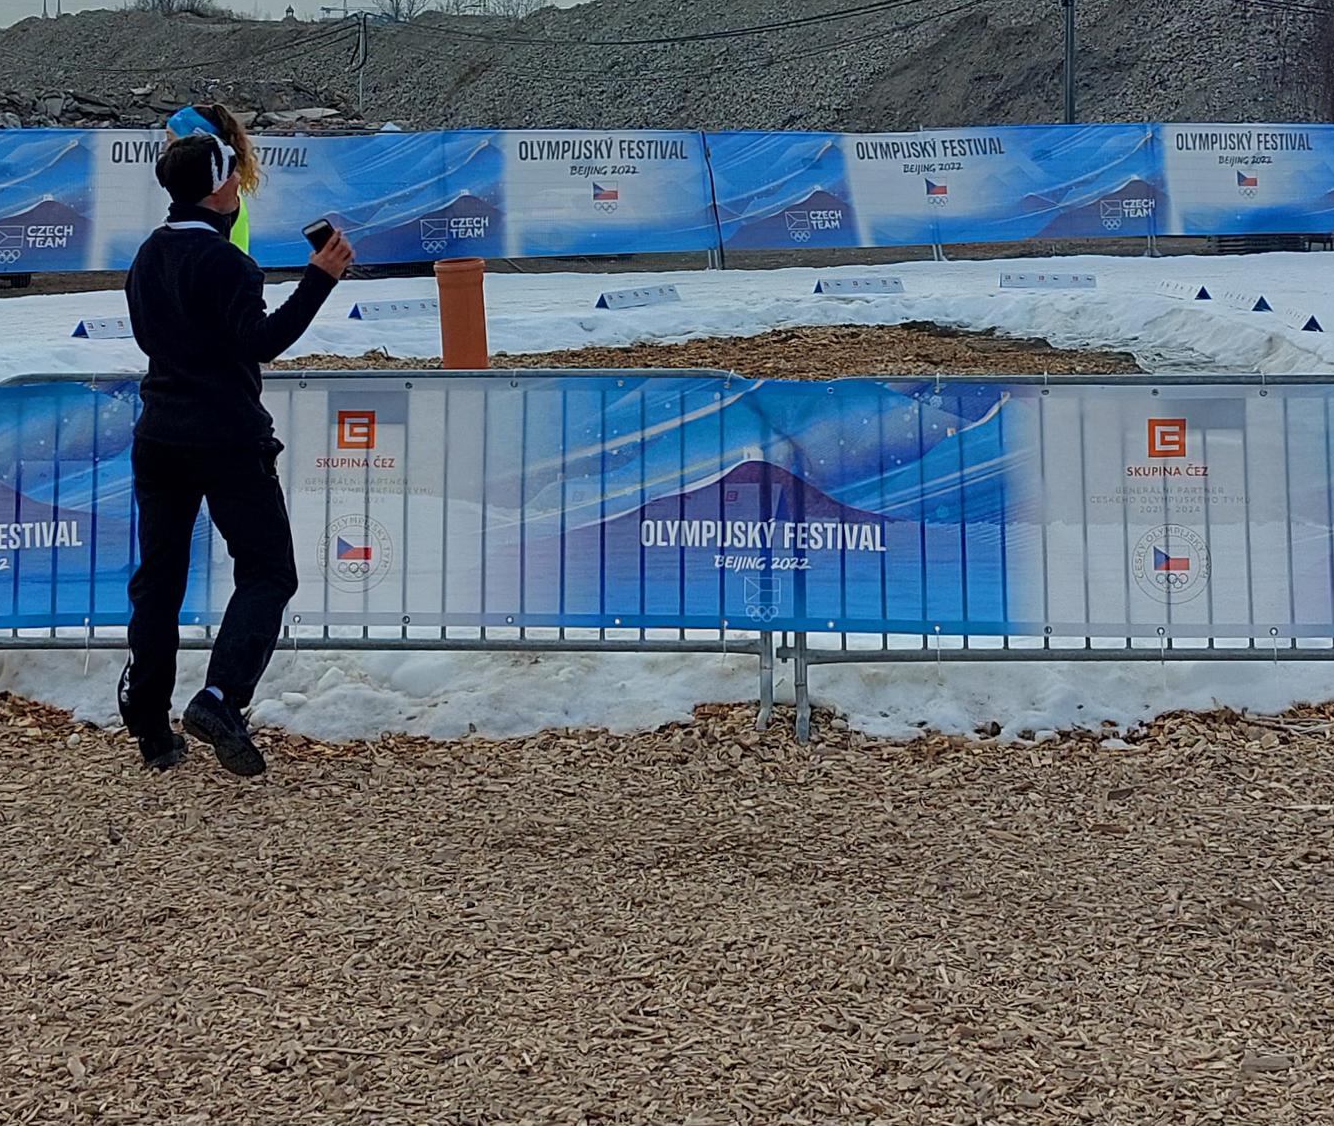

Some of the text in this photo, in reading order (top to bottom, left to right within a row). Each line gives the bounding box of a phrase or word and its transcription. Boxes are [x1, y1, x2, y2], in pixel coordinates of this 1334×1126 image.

[1175, 129, 1314, 152] OLYMPIJSKÝ FESTIVAL
[517, 137, 689, 162] OLYMPIJSKÝ FESTIVAL
[855, 136, 1006, 160] OLYMPIJSKÝ FESTIVAL
[1218, 155, 1273, 167] BEIJING 2022
[569, 164, 642, 178] BEIJING 2022
[903, 162, 964, 175] BEIJING 2022
[1122, 197, 1156, 209] CZECH
[809, 209, 843, 221] CZECH
[1122, 208, 1152, 219] TEAM
[450, 217, 489, 229] CZECH
[811, 220, 840, 231] TEAM
[27, 223, 74, 237] CZECH
[450, 228, 485, 239] TEAM
[27, 236, 67, 249] TEAM
[316, 455, 395, 469] SKUPINA ČEZ
[1127, 463, 1209, 477] SKUPINA ČEZ
[641, 518, 886, 552] OLYMPIJSKÝ FESTIVAL
[714, 554, 812, 574] BEIJING 2022
